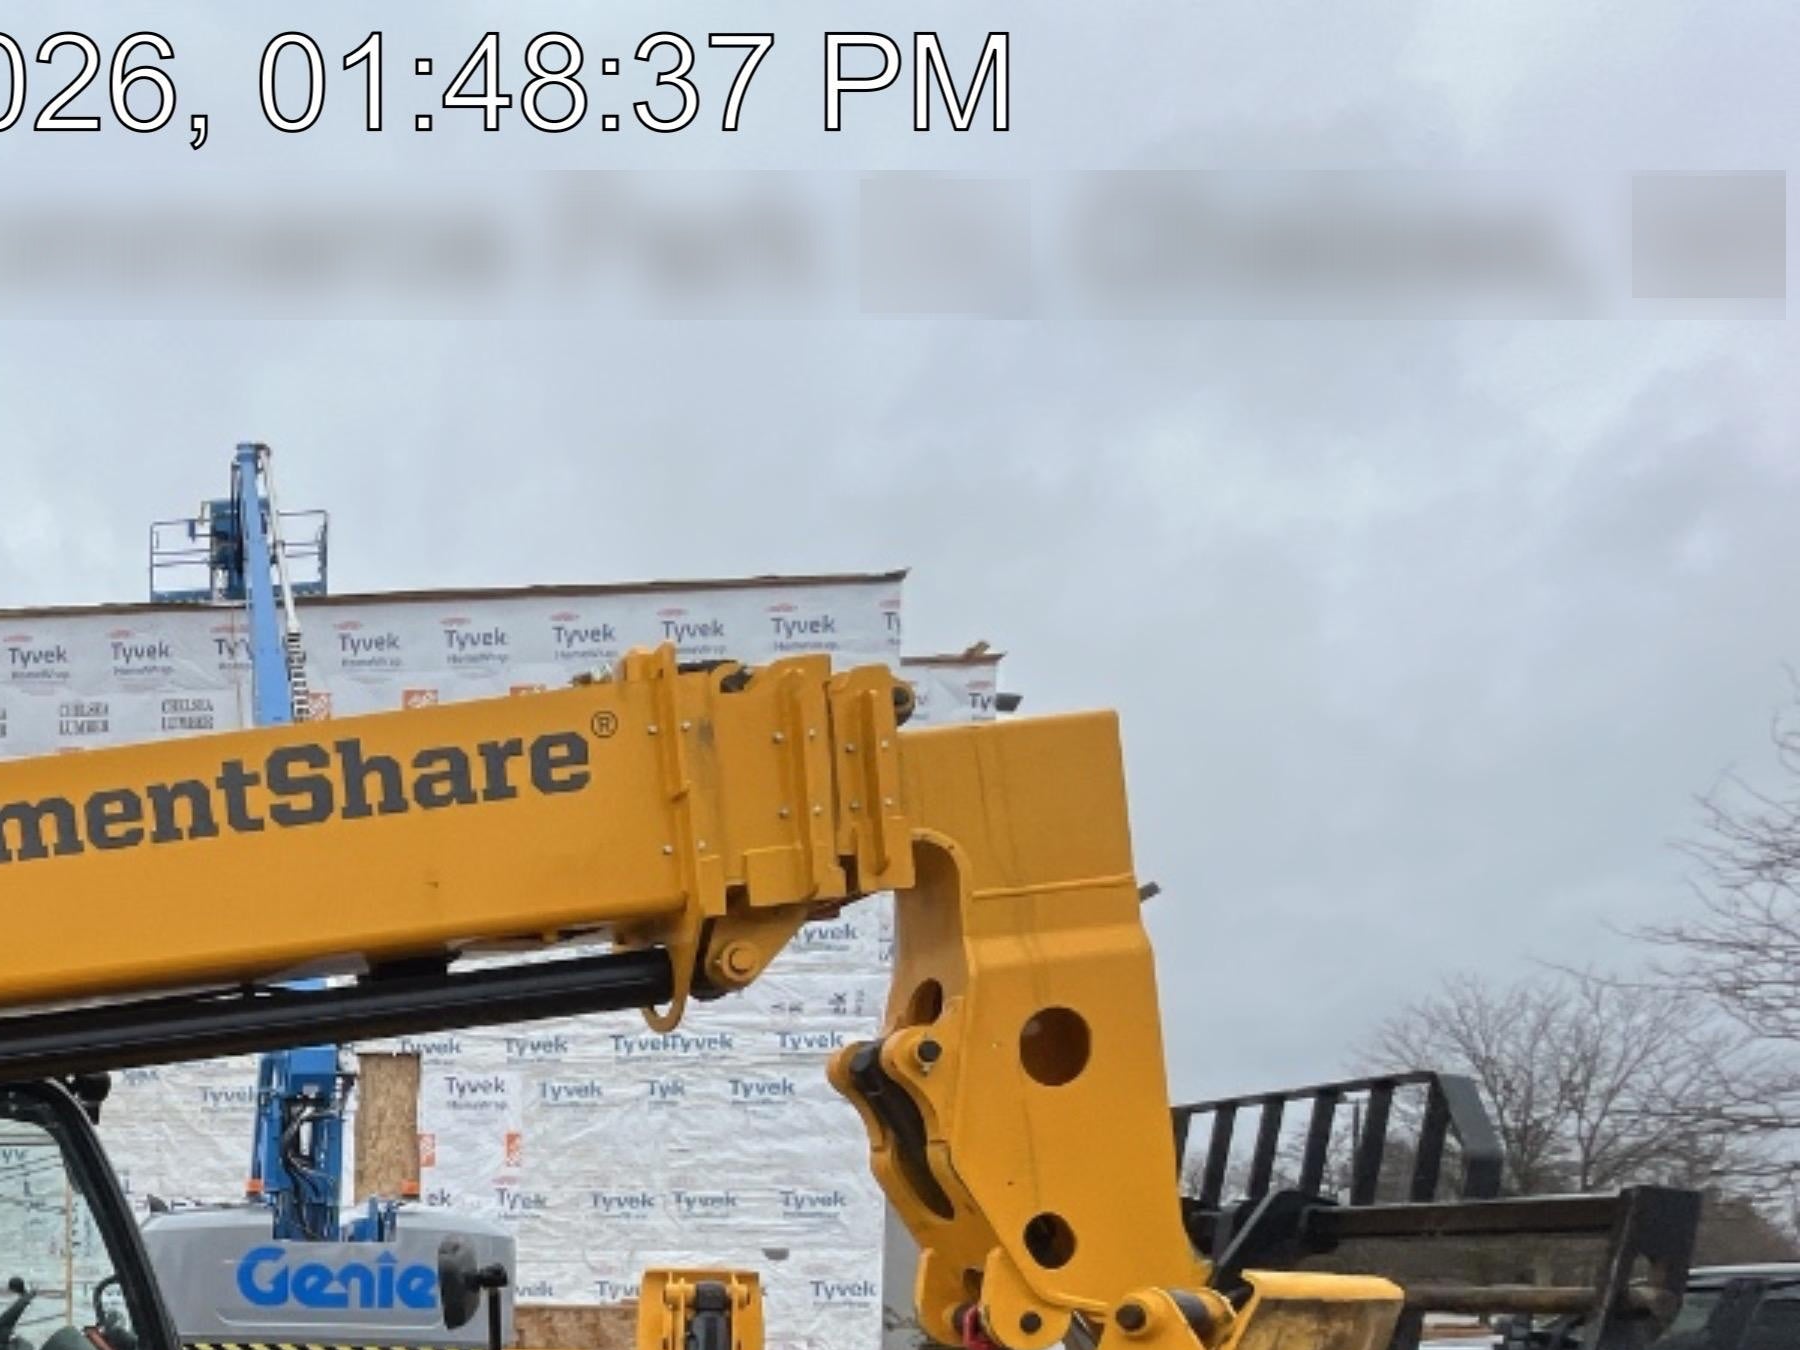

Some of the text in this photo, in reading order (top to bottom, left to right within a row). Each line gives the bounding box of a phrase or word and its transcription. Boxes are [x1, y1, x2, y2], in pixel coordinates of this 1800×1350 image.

[552, 623, 615, 648] Tyvek
[662, 619, 724, 643] Tyvek
[771, 614, 836, 639] Tyvek
[338, 632, 399, 655] Tyvek
[444, 627, 507, 651] Tyvek
[8, 645, 67, 668] Tyvek
[111, 641, 170, 664] Tyvek
[505, 1036, 568, 1055] Tyvek
[776, 1031, 844, 1049] Tyvek
[444, 1077, 506, 1096] Tyvek
[539, 1081, 602, 1100] Tyvek
[728, 1078, 795, 1097] Tyvek
[591, 1191, 654, 1212] Tyvek
[672, 1191, 736, 1211] Tyvek
[779, 1191, 846, 1211] Tyvek
[236, 1245, 438, 1310] Genie
[810, 1280, 877, 1300] Tyvek
